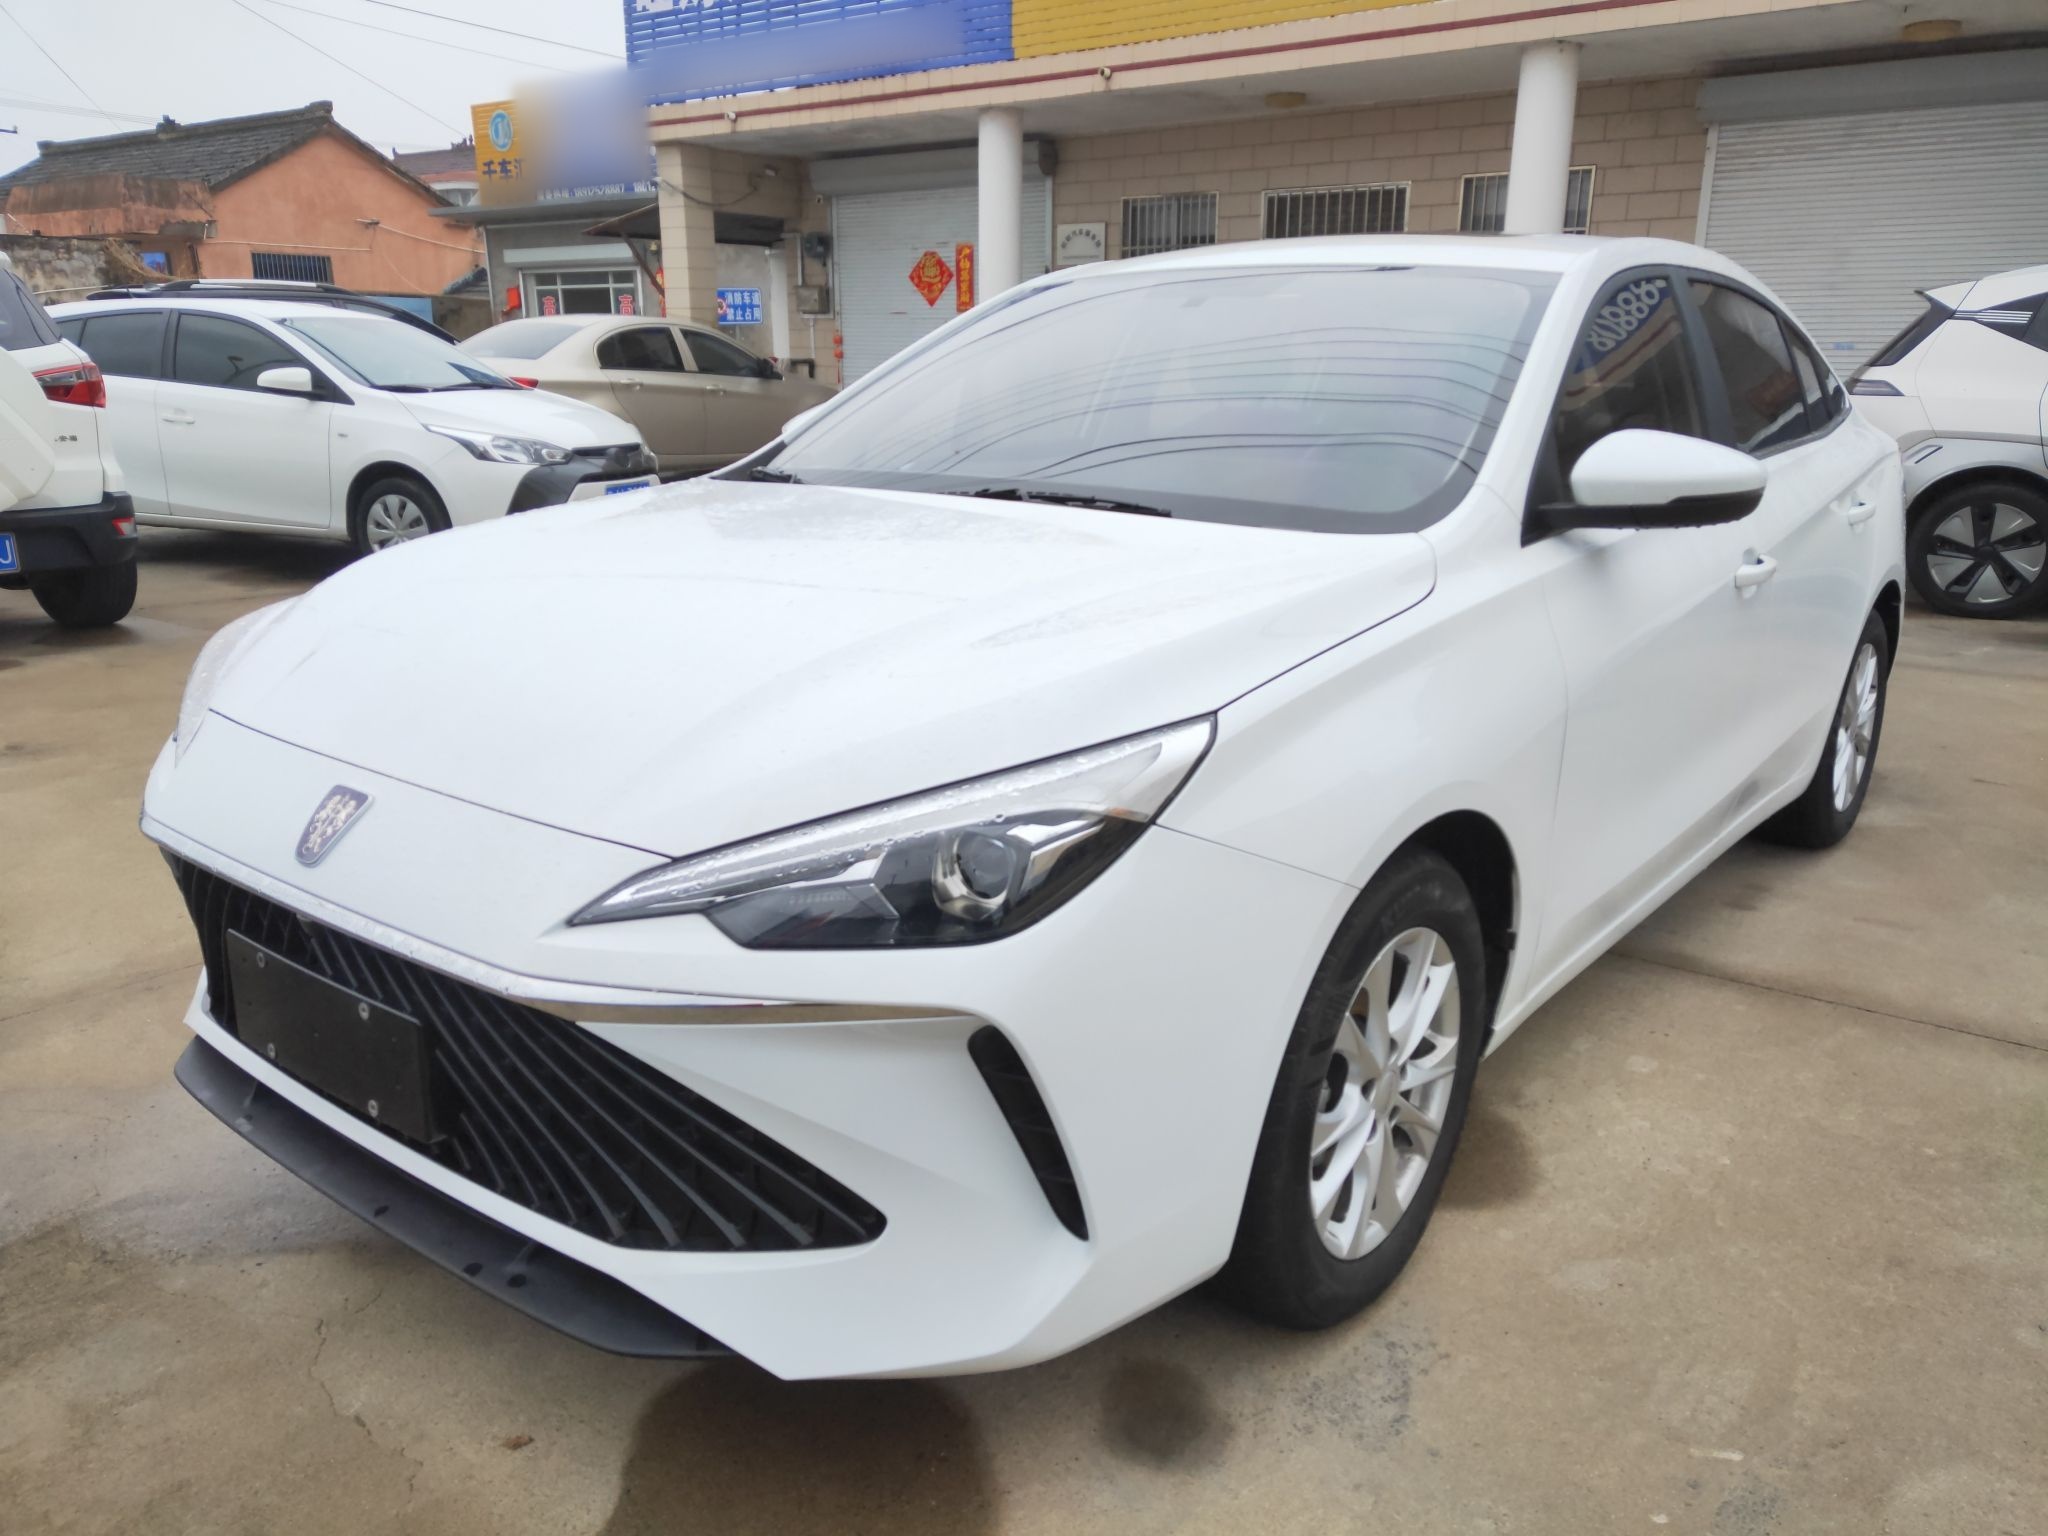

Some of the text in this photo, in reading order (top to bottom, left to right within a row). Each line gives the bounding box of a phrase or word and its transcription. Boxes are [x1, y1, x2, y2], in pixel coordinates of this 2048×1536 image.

[543, 295, 556, 317] 高
[618, 294, 634, 317] 高
[725, 291, 761, 305] 消防车道
[726, 307, 761, 321] 禁止占用
